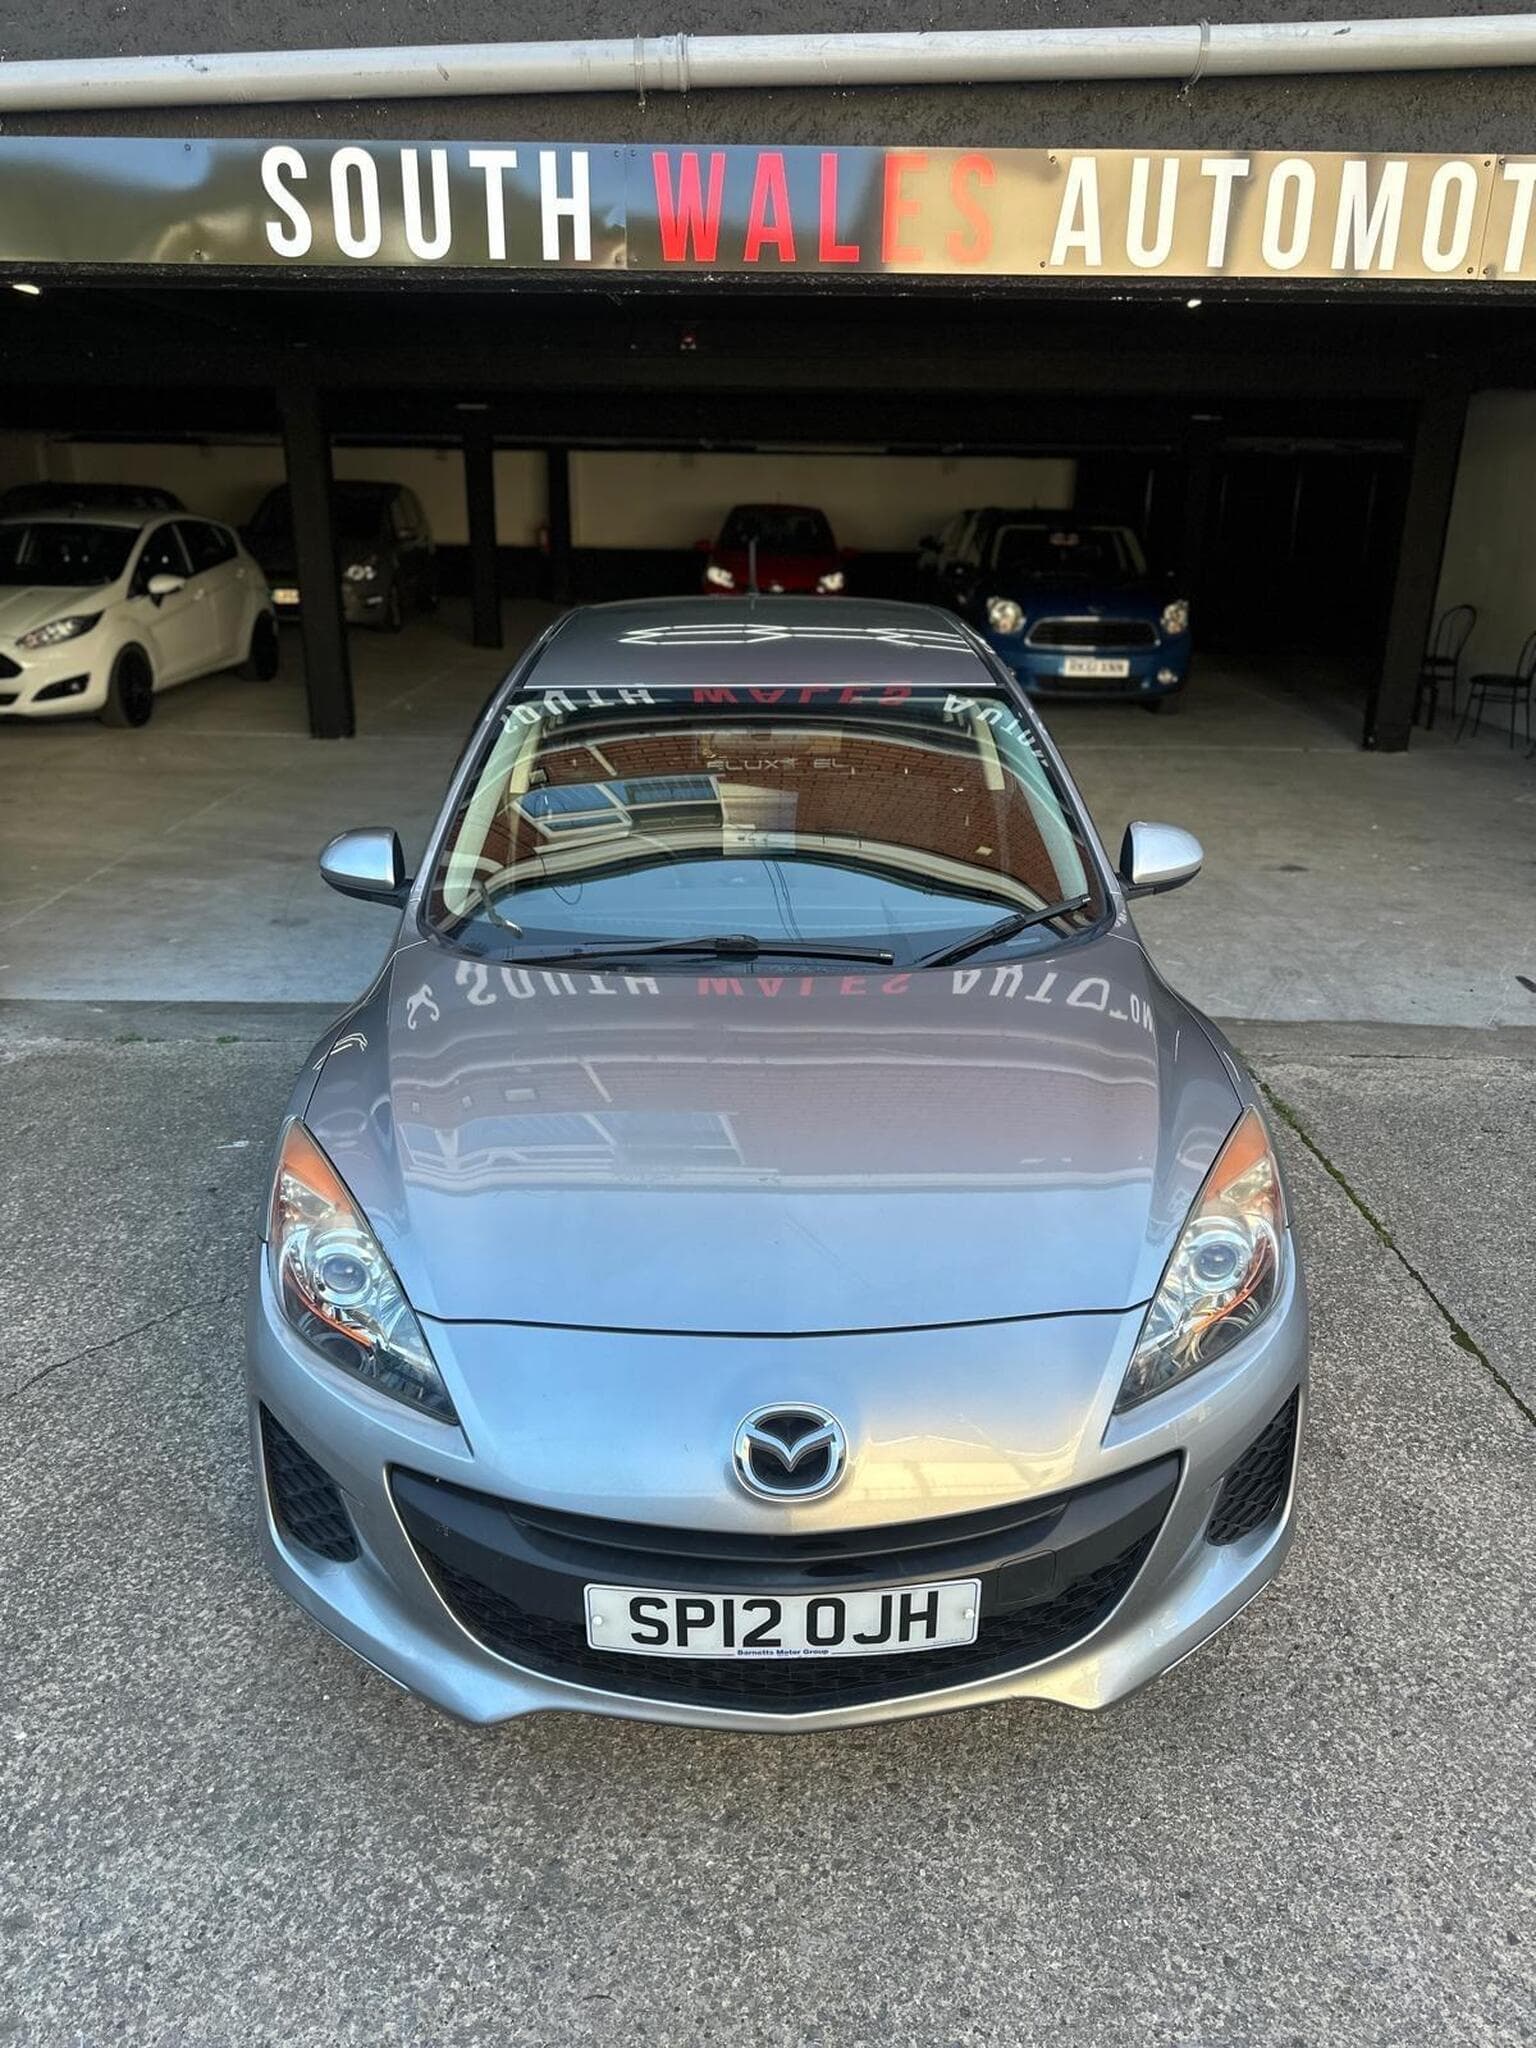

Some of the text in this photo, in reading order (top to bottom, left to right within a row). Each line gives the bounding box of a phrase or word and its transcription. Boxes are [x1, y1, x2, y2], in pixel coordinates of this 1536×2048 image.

[261, 145, 592, 261] SOUTH
[652, 150, 997, 264] WALES
[629, 1590, 939, 1648] SP12 OJH
